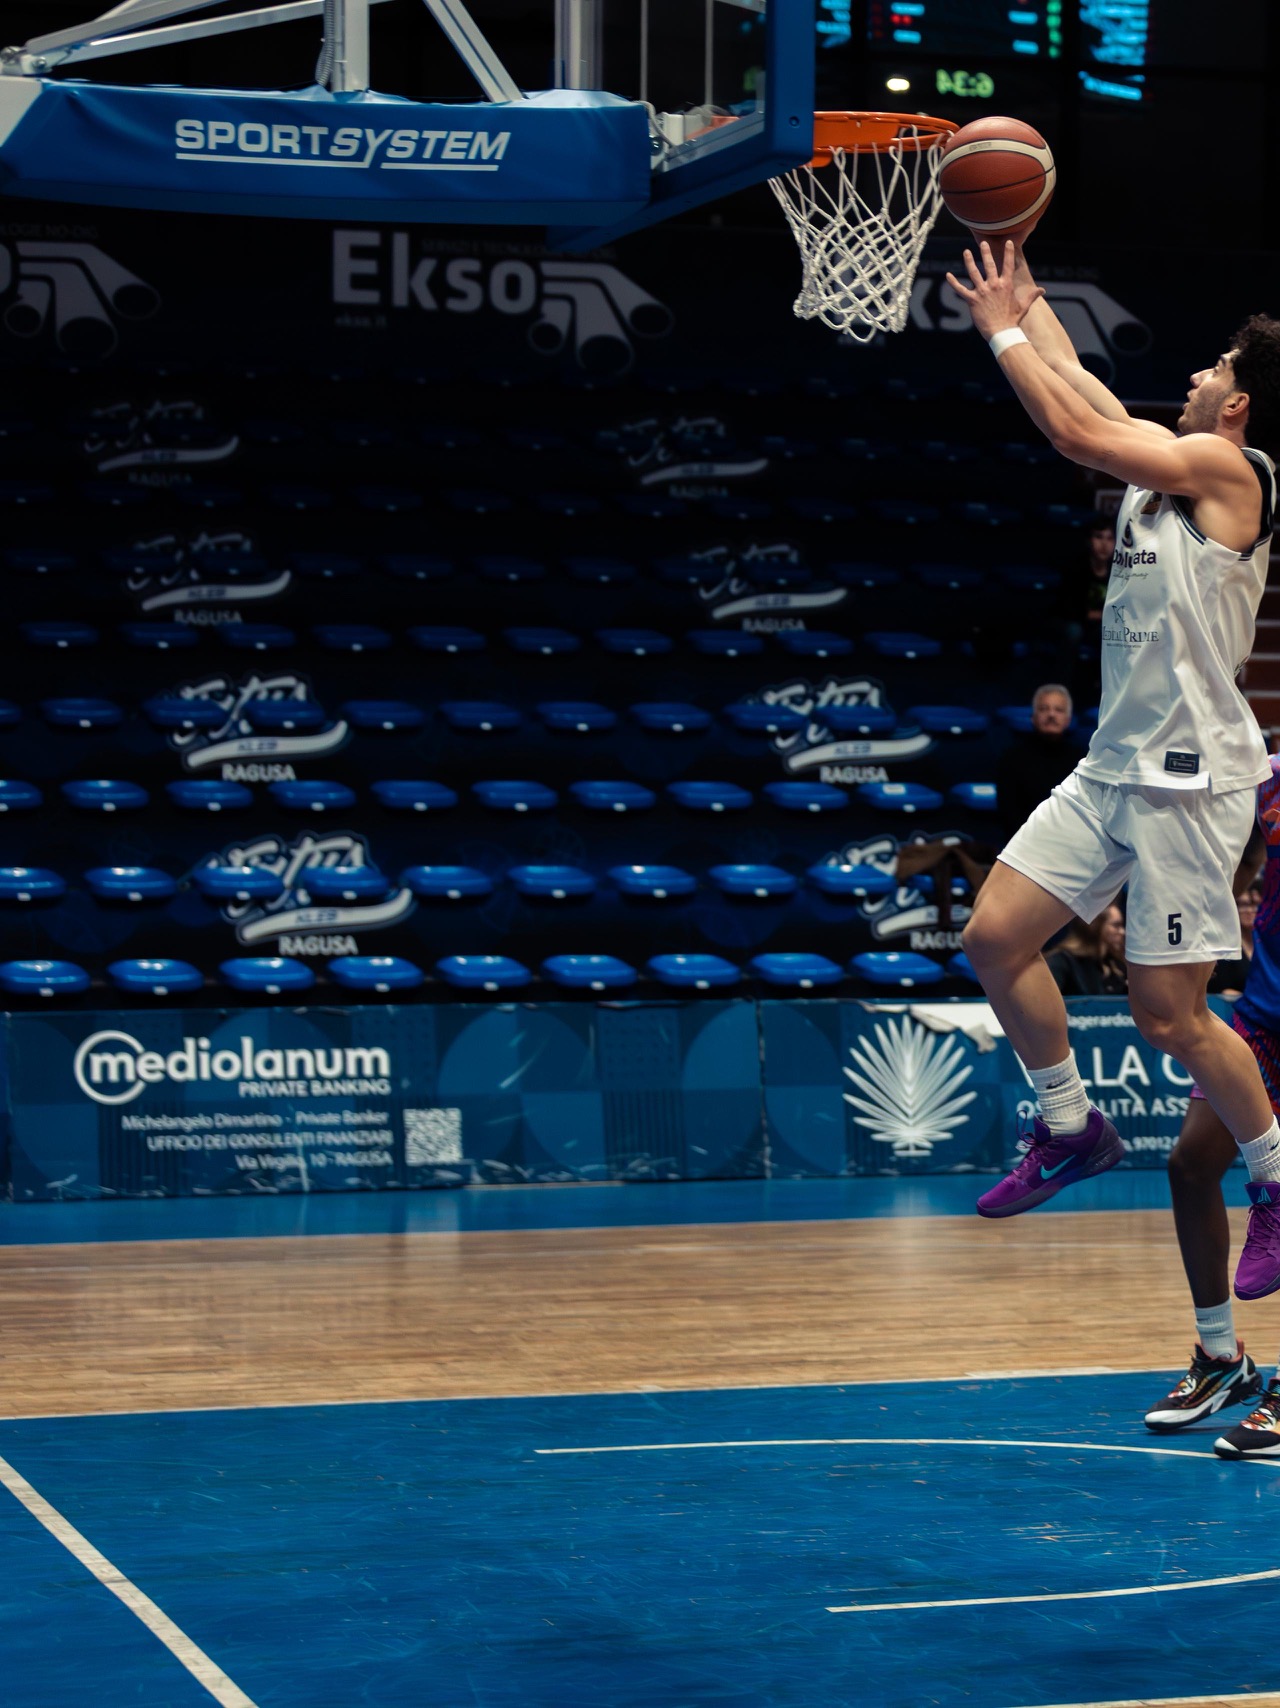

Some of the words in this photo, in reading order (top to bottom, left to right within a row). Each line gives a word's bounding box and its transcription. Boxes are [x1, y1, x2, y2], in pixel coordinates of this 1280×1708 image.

[176, 118, 511, 168] SPORTSYSTEM
[332, 228, 538, 316] Ekso
[173, 608, 243, 626] RAGUSA
[741, 617, 806, 633] RAGUSA
[221, 763, 297, 782] RAGUSA
[819, 766, 889, 784] RAGUSA
[1167, 913, 1182, 946] 5
[277, 936, 359, 956] RAGUSA
[88, 1035, 392, 1084] mediolanum
[238, 1081, 309, 1098] PRIVATE
[310, 1079, 392, 1097] BANKING
[121, 1114, 213, 1132] Michelangelo
[295, 1110, 340, 1125] Private
[341, 1109, 389, 1125] Banker
[146, 1135, 201, 1151] UFFICIO
[203, 1134, 227, 1149] DEI
[228, 1131, 315, 1149] CONSULENTI
